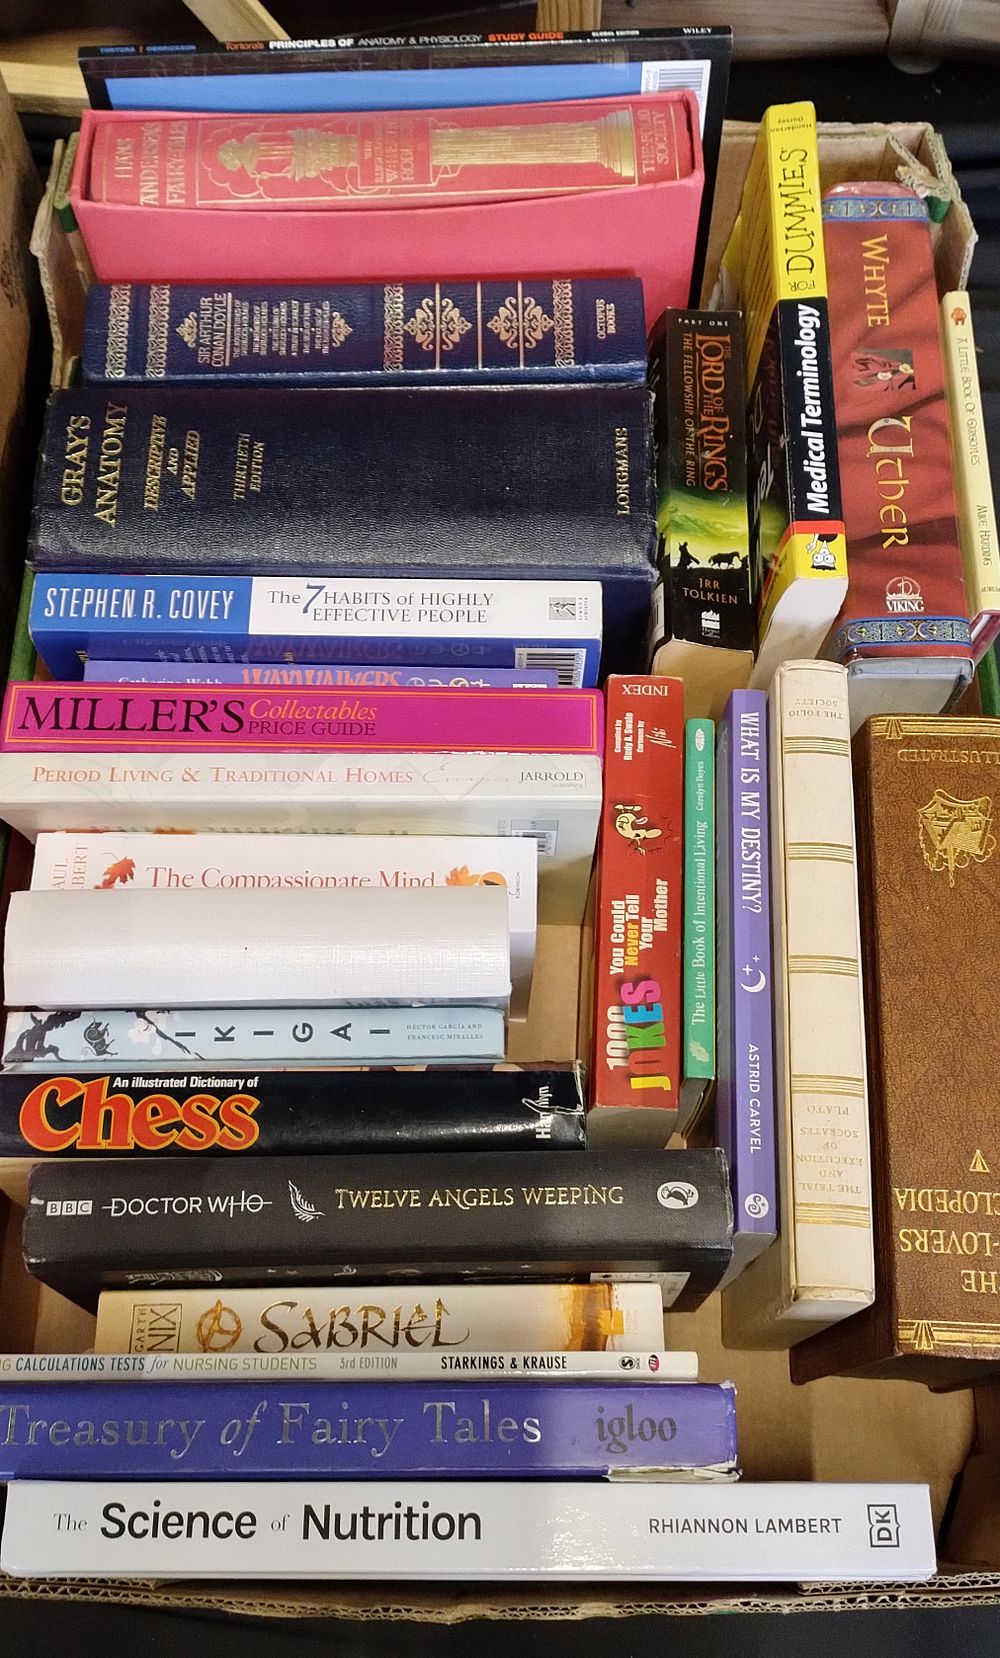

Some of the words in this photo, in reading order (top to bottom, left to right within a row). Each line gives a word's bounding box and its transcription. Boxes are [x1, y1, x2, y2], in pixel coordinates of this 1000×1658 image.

[269, 38, 336, 49] PRINCIPLES
[338, 38, 354, 46] OF
[358, 37, 406, 46] ANATOMY
[408, 36, 416, 45] &
[419, 34, 482, 44] PHYSIOLOGY
[488, 33, 525, 42] STUDY
[528, 32, 564, 40] GUIDE
[778, 148, 816, 275] DUMMIES
[861, 234, 890, 327] WHYTE
[199, 296, 213, 345] ARTHUR
[213, 292, 227, 329] DOYLE
[596, 298, 606, 340] OCTOPUS
[606, 303, 616, 334] BOOKS
[678, 318, 702, 326] PART
[198, 346, 210, 364] SIR
[212, 332, 226, 367] CONAN
[682, 332, 692, 350] THE
[696, 334, 731, 394] LORD
[794, 303, 822, 428] Terminology
[684, 354, 694, 415] FELLOWSHIP
[703, 394, 714, 415] THE
[684, 418, 695, 434] OF
[61, 416, 92, 506] GRAY'S
[167, 448, 180, 476] AND
[685, 435, 696, 456] THE
[697, 414, 730, 491] RINGS
[94, 401, 128, 528] ANATOMY
[144, 414, 168, 512] DESCRIPTIVE
[181, 430, 200, 500] APPLIED
[233, 432, 251, 502] THIRTIETH
[250, 441, 265, 493] EDITION
[614, 427, 630, 516] LONGMANS
[686, 459, 696, 487] RING
[801, 431, 830, 514] Medical
[268, 590, 301, 604] The
[302, 583, 327, 614] 7
[324, 591, 391, 606] HABITS
[396, 592, 418, 606] of
[420, 592, 494, 607] HIGHLY
[682, 587, 738, 604] TOLKIEN
[698, 578, 720, 590] JRR
[44, 587, 136, 619] STEPHEN
[142, 589, 162, 619] R.
[169, 589, 234, 620] COVEY
[312, 608, 412, 622] EFFECTIVE
[418, 608, 488, 624] PEOPLE
[886, 600, 925, 612] VIKING
[622, 684, 668, 696] INDEX
[18, 697, 246, 734] MILLER'S
[250, 699, 378, 720] Collectables
[248, 721, 306, 735] PRICE
[311, 722, 376, 736] GUIDE
[740, 712, 760, 761] WHAT
[32, 766, 101, 782] PERIOD
[108, 767, 174, 783] LIVING
[181, 767, 200, 782] &
[210, 767, 338, 783] TRADITIONAL
[344, 768, 414, 784] HOMES
[518, 772, 584, 784] JARROLD
[741, 768, 760, 784] IS
[741, 792, 761, 820] MY
[694, 820, 708, 852] Living
[146, 866, 194, 888] The
[200, 867, 371, 888] Compassionate
[379, 870, 435, 888] Mind
[692, 855, 706, 916] Intentional
[741, 827, 762, 914] DESTINY?
[626, 894, 640, 922] Tell
[654, 878, 668, 932] Mother
[610, 900, 626, 944] Could
[639, 916, 654, 952] Your
[692, 920, 706, 933] of
[624, 922, 640, 966] Never
[692, 936, 706, 969] Book
[610, 948, 624, 975] You
[692, 972, 706, 1000] Little
[692, 1002, 706, 1026] The
[174, 1022, 390, 1043] IKIGAI
[606, 1005, 630, 1070] 1000
[620, 979, 672, 1091] JOKES
[112, 1076, 130, 1088] An
[131, 1076, 187, 1088] illustrated
[190, 1076, 245, 1090] Dictionary
[246, 1076, 260, 1088] of
[748, 1043, 760, 1093] ASTRID
[19, 1076, 261, 1152] Chess
[749, 1098, 762, 1154] CARVEL
[806, 1104, 849, 1116] PLATO
[800, 1126, 859, 1138] SOCRATES
[798, 1182, 835, 1193] TRIAL
[819, 1170, 843, 1178] AND
[838, 1184, 861, 1194] THE
[46, 1200, 93, 1216] BBC
[102, 1196, 202, 1217] DOCTOR
[207, 1190, 273, 1218] WHO
[334, 1188, 422, 1210] TWELVE
[428, 1188, 514, 1212] ANGELS
[521, 1184, 624, 1206] WEEPING
[148, 1306, 178, 1352] NIX
[15, 1356, 106, 1372] CALCULATIONS
[110, 1356, 146, 1372] TESTS
[146, 1356, 170, 1374] for
[173, 1357, 239, 1371] NURSING
[242, 1357, 318, 1370] STUDENTS
[340, 1356, 356, 1369] 3rd
[359, 1356, 398, 1370] EDITION
[440, 1356, 505, 1370] STARKINGS
[510, 1356, 518, 1369] &
[522, 1356, 568, 1370] KRAUSE
[0, 1404, 206, 1460] Treasury
[220, 1400, 268, 1457] of
[276, 1401, 404, 1458] Fairy
[423, 1398, 542, 1444] Tales
[594, 1403, 678, 1454] igloo
[53, 1512, 88, 1532] The
[100, 1500, 257, 1540] Science
[270, 1514, 290, 1532] of
[302, 1500, 482, 1542] Nutrition
[650, 1518, 748, 1534] RHIANNON
[755, 1518, 842, 1534] LAMBERT
[876, 1510, 893, 1542] DK
